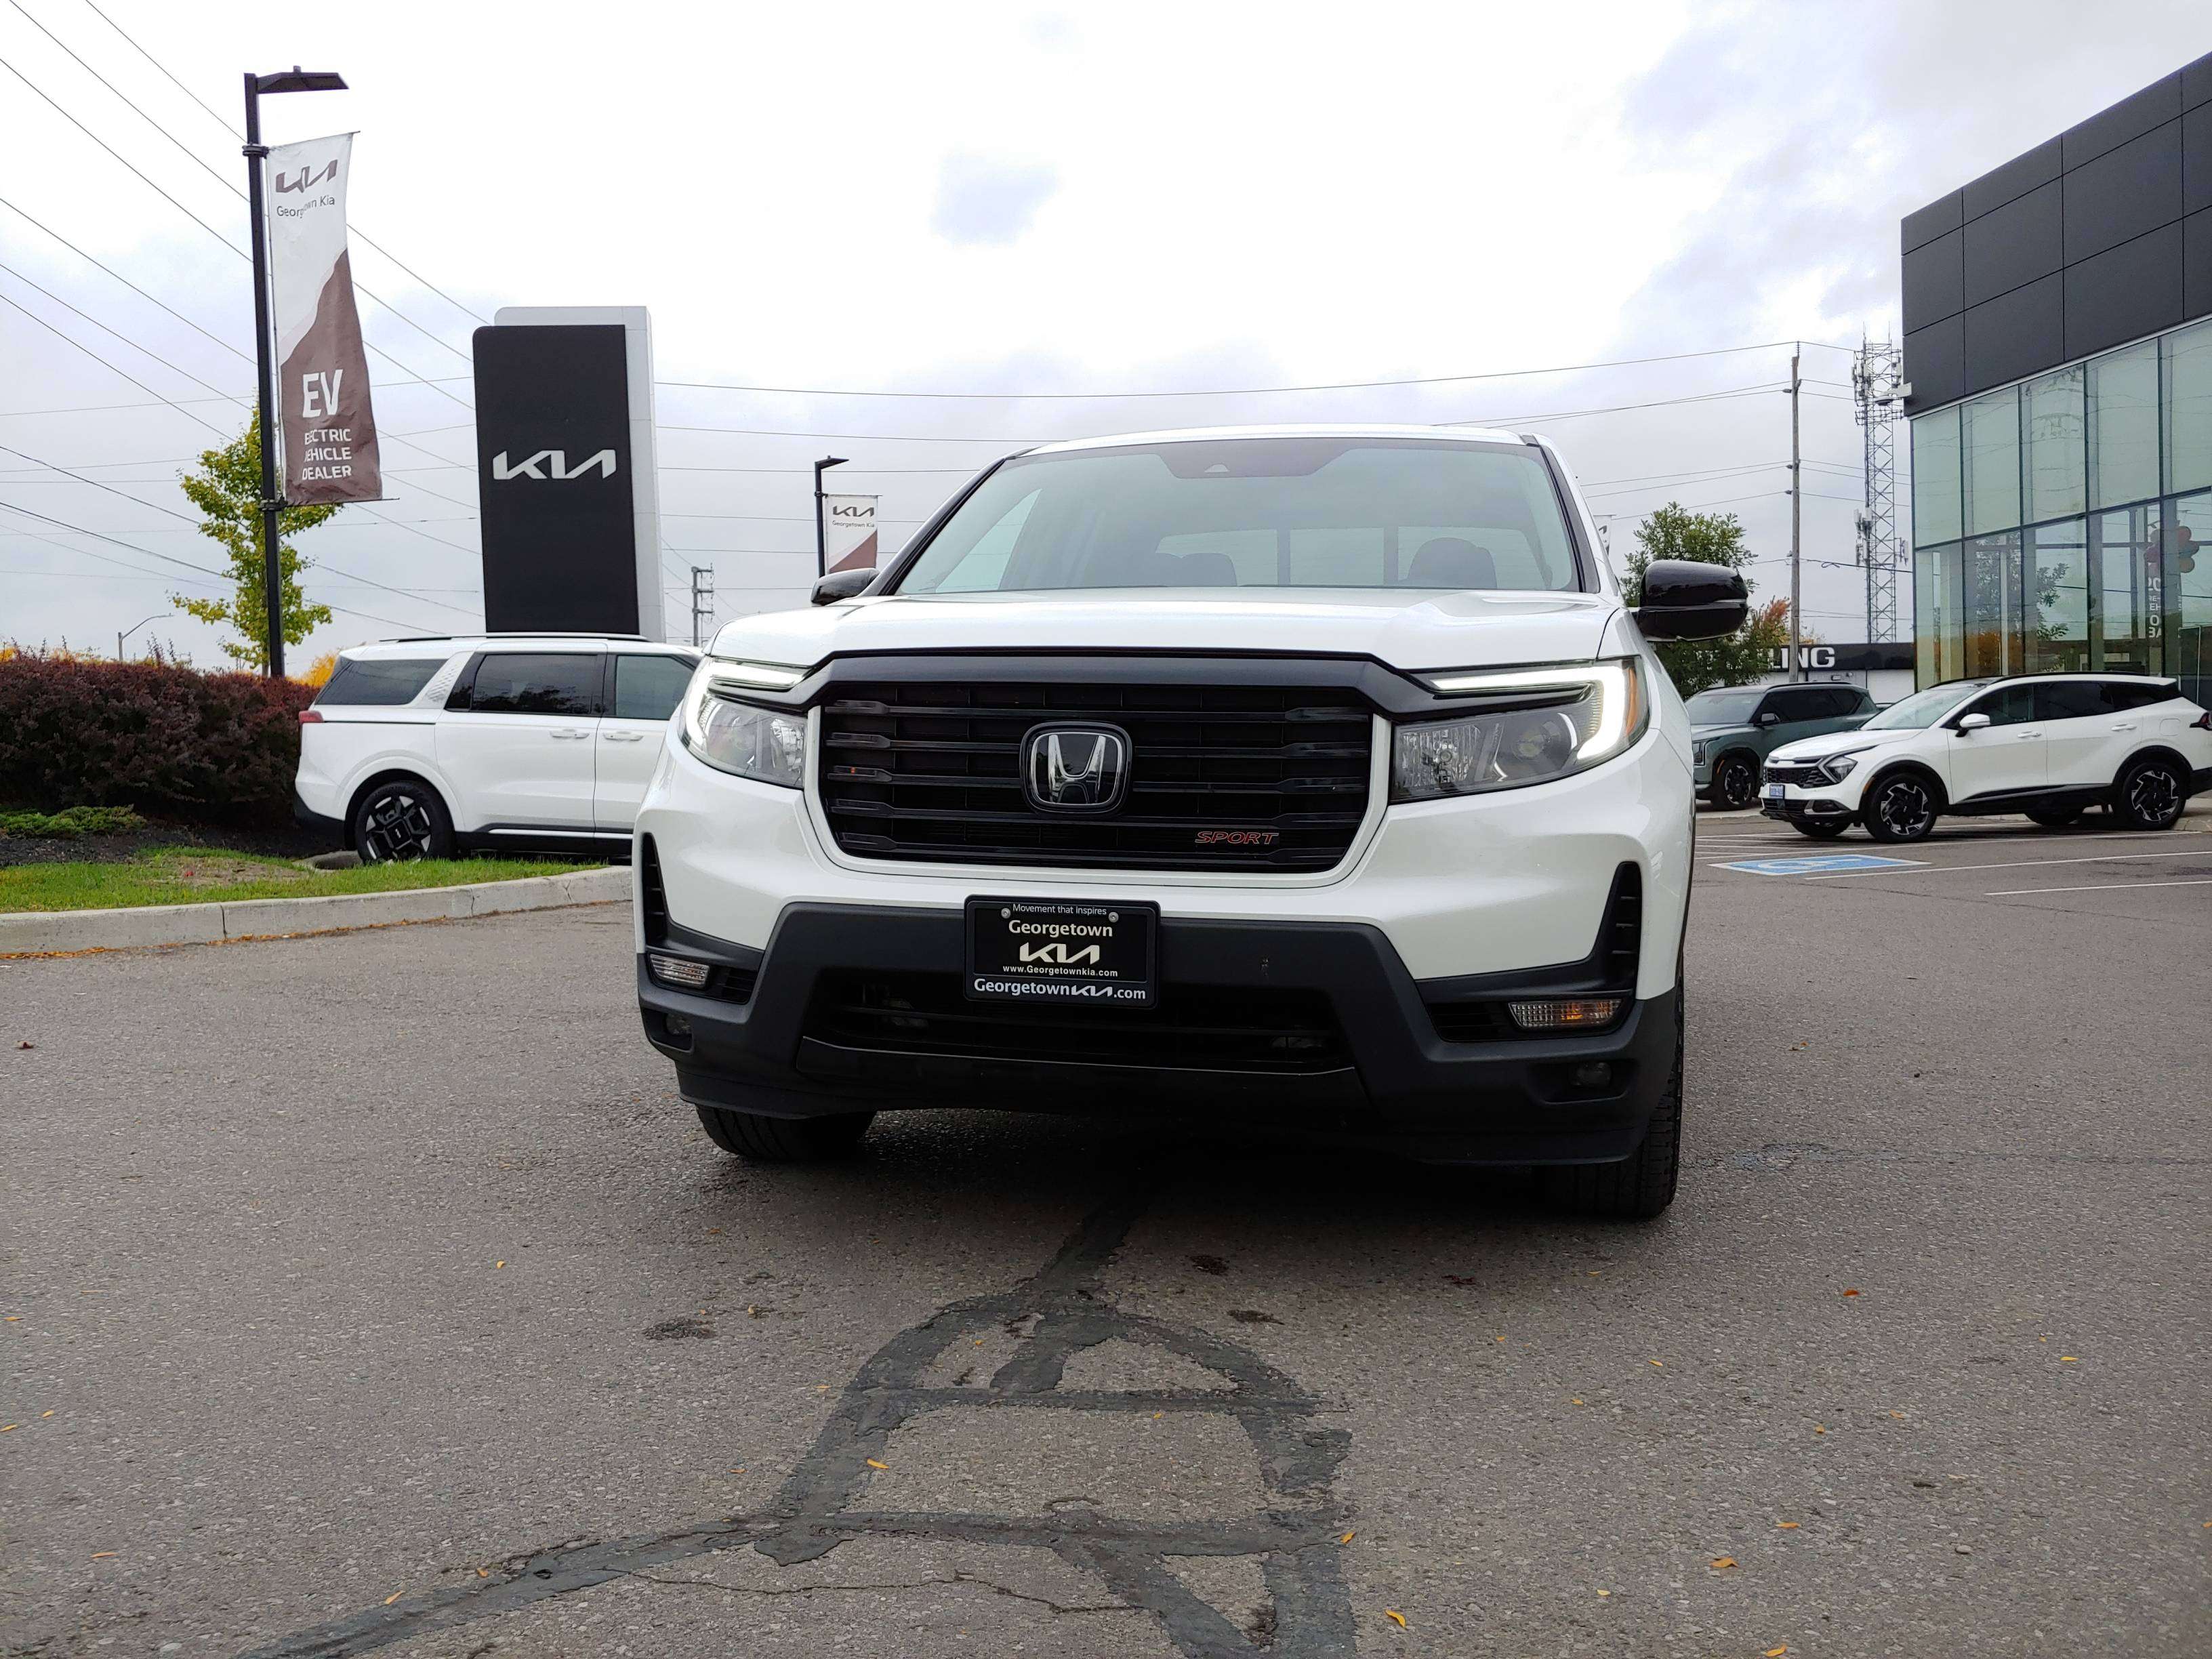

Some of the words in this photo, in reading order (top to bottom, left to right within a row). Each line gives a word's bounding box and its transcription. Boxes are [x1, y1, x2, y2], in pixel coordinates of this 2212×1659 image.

[320, 194, 335, 207] Kia
[302, 369, 344, 418] EV
[493, 449, 616, 480] KIA
[302, 465, 352, 480] DEALER
[1195, 831, 1279, 845] SPORT
[1012, 903, 1055, 914] Movement
[1057, 906, 1073, 914] that
[1076, 906, 1107, 916] inspires
[1008, 920, 1113, 938] Georgetown
[1002, 965, 1118, 977] www.Georgetownkia.com
